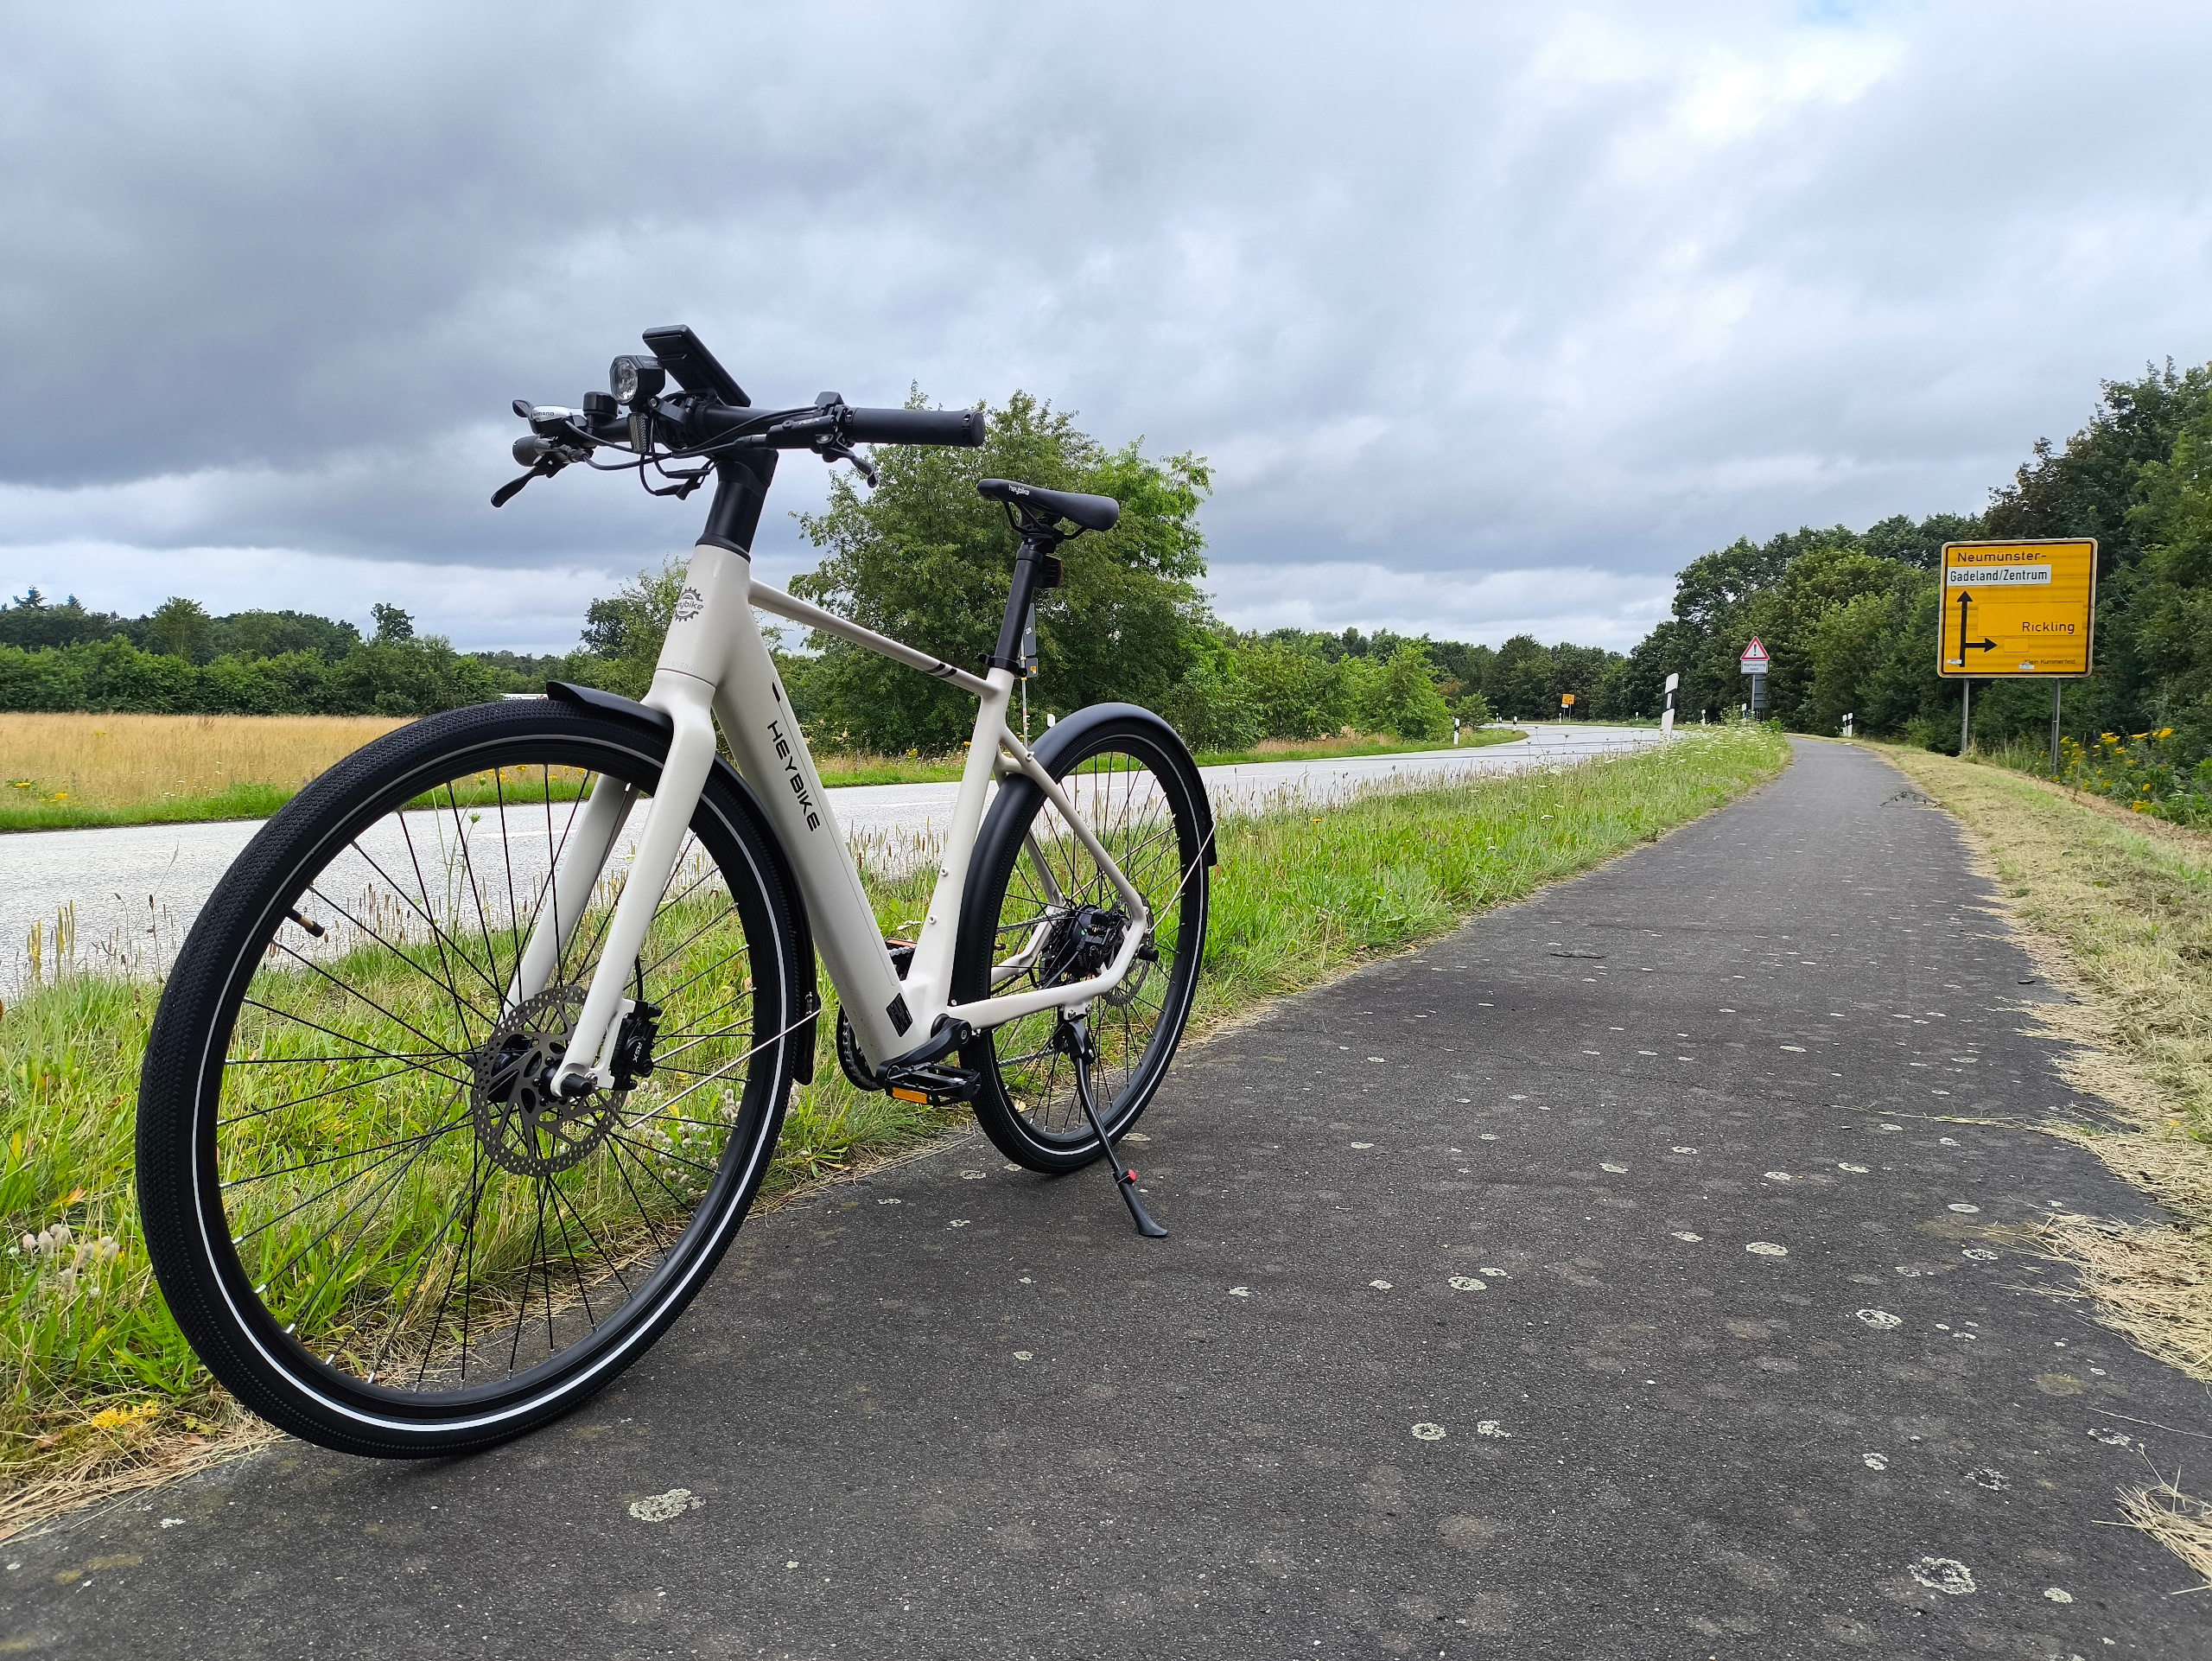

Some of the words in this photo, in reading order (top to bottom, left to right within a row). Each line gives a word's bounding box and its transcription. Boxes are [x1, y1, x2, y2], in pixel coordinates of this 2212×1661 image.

[1957, 550, 2047, 563] Neumünster-
[1950, 570, 2048, 582] Gadeland/Zentrum
[2022, 620, 2075, 634] Rickling
[766, 719, 821, 832] HEYBIKE
